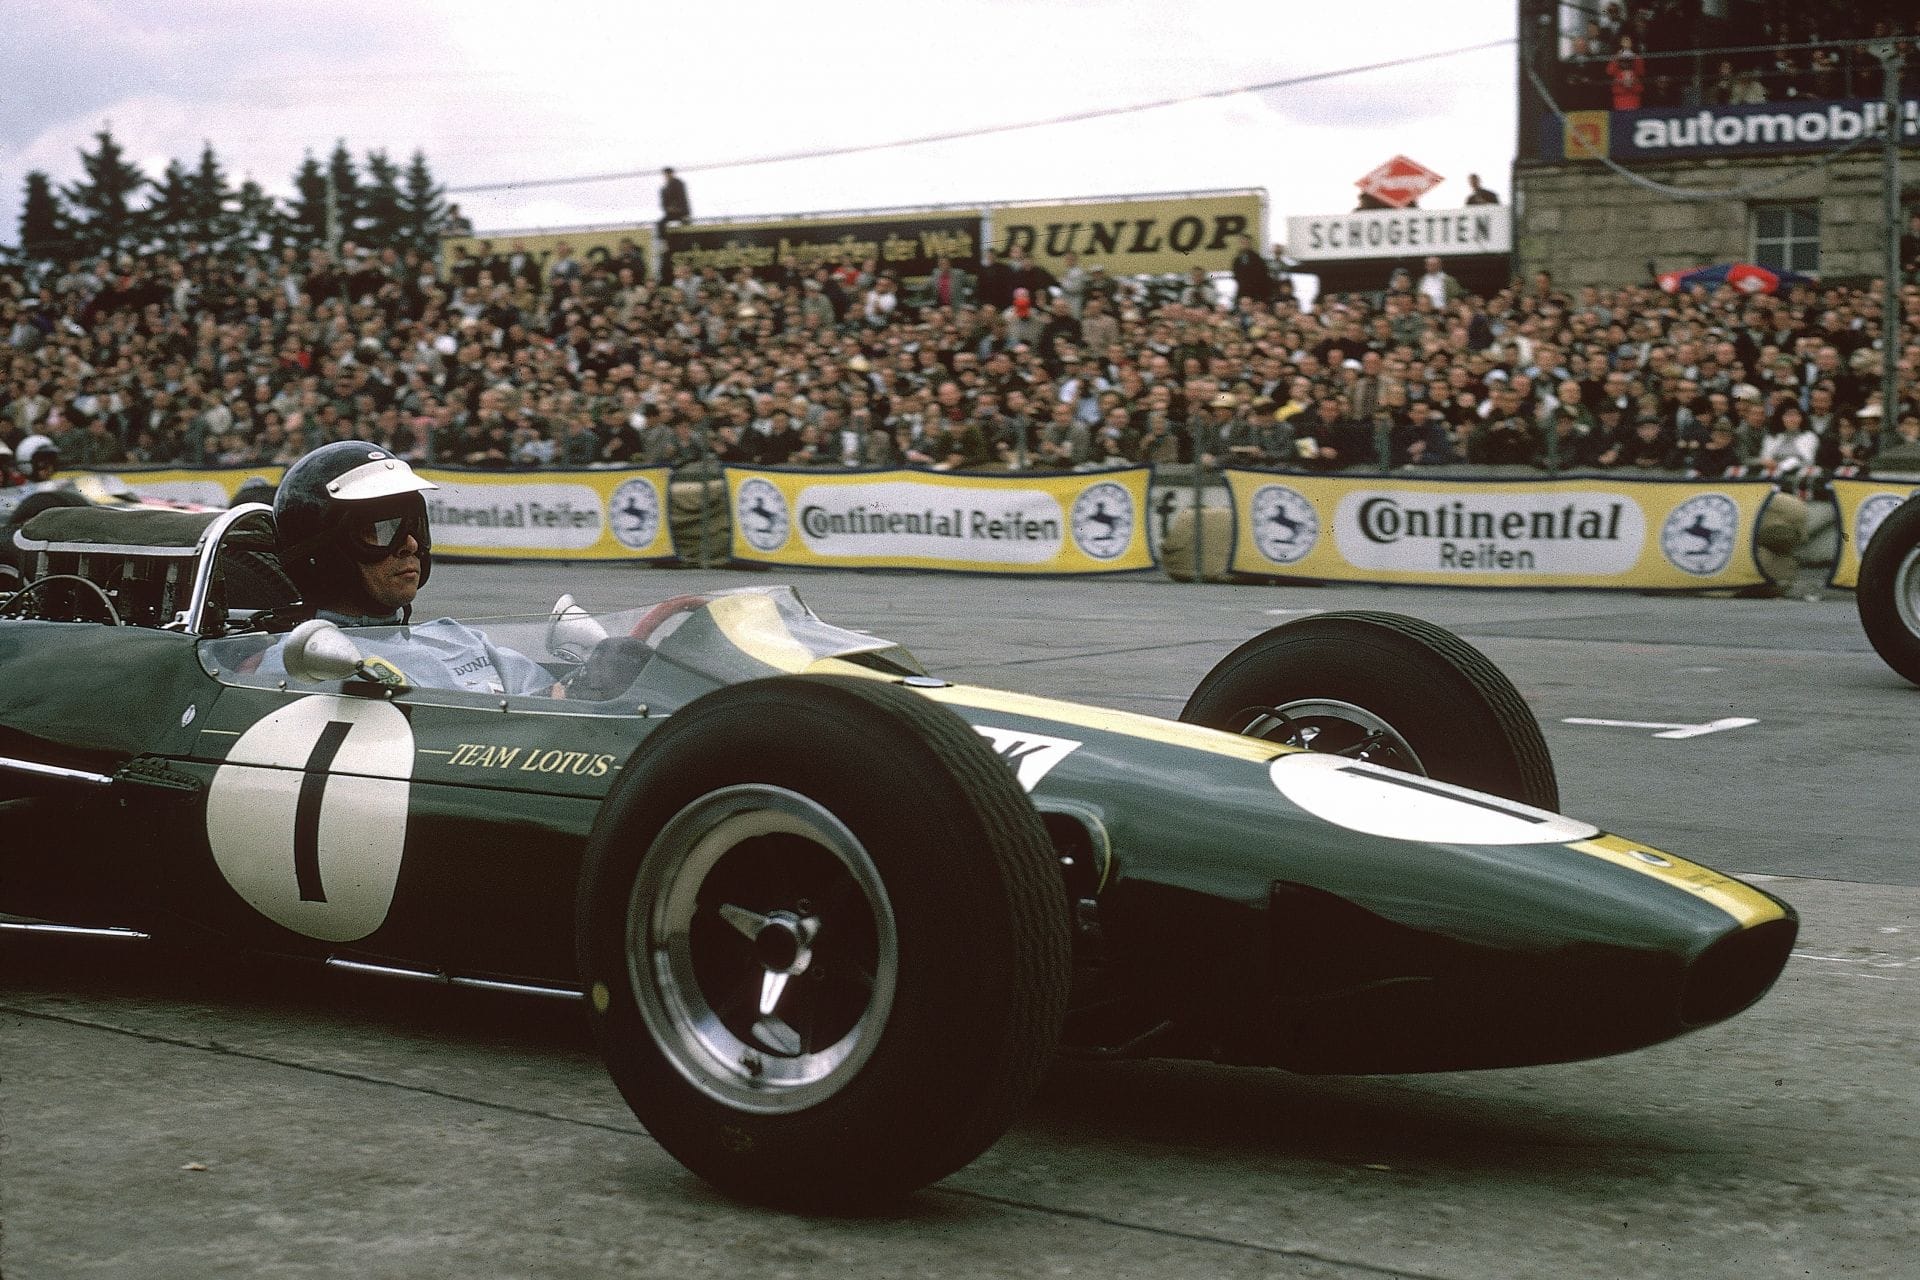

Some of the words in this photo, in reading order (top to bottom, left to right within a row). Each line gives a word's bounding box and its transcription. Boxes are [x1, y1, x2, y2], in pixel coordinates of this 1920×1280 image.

[997, 215, 1248, 258] DUNLOP
[1310, 214, 1492, 249] SCHOGETTEN
[428, 501, 524, 527] tinental
[802, 505, 962, 538] Continental
[971, 510, 1061, 540] Reifen
[1358, 497, 1622, 544] Continental
[1439, 542, 1535, 570] Reifen
[453, 656, 496, 676] DUNL
[447, 743, 522, 769] TEAM
[519, 749, 617, 777] LOTUS
[293, 720, 354, 904] 1
